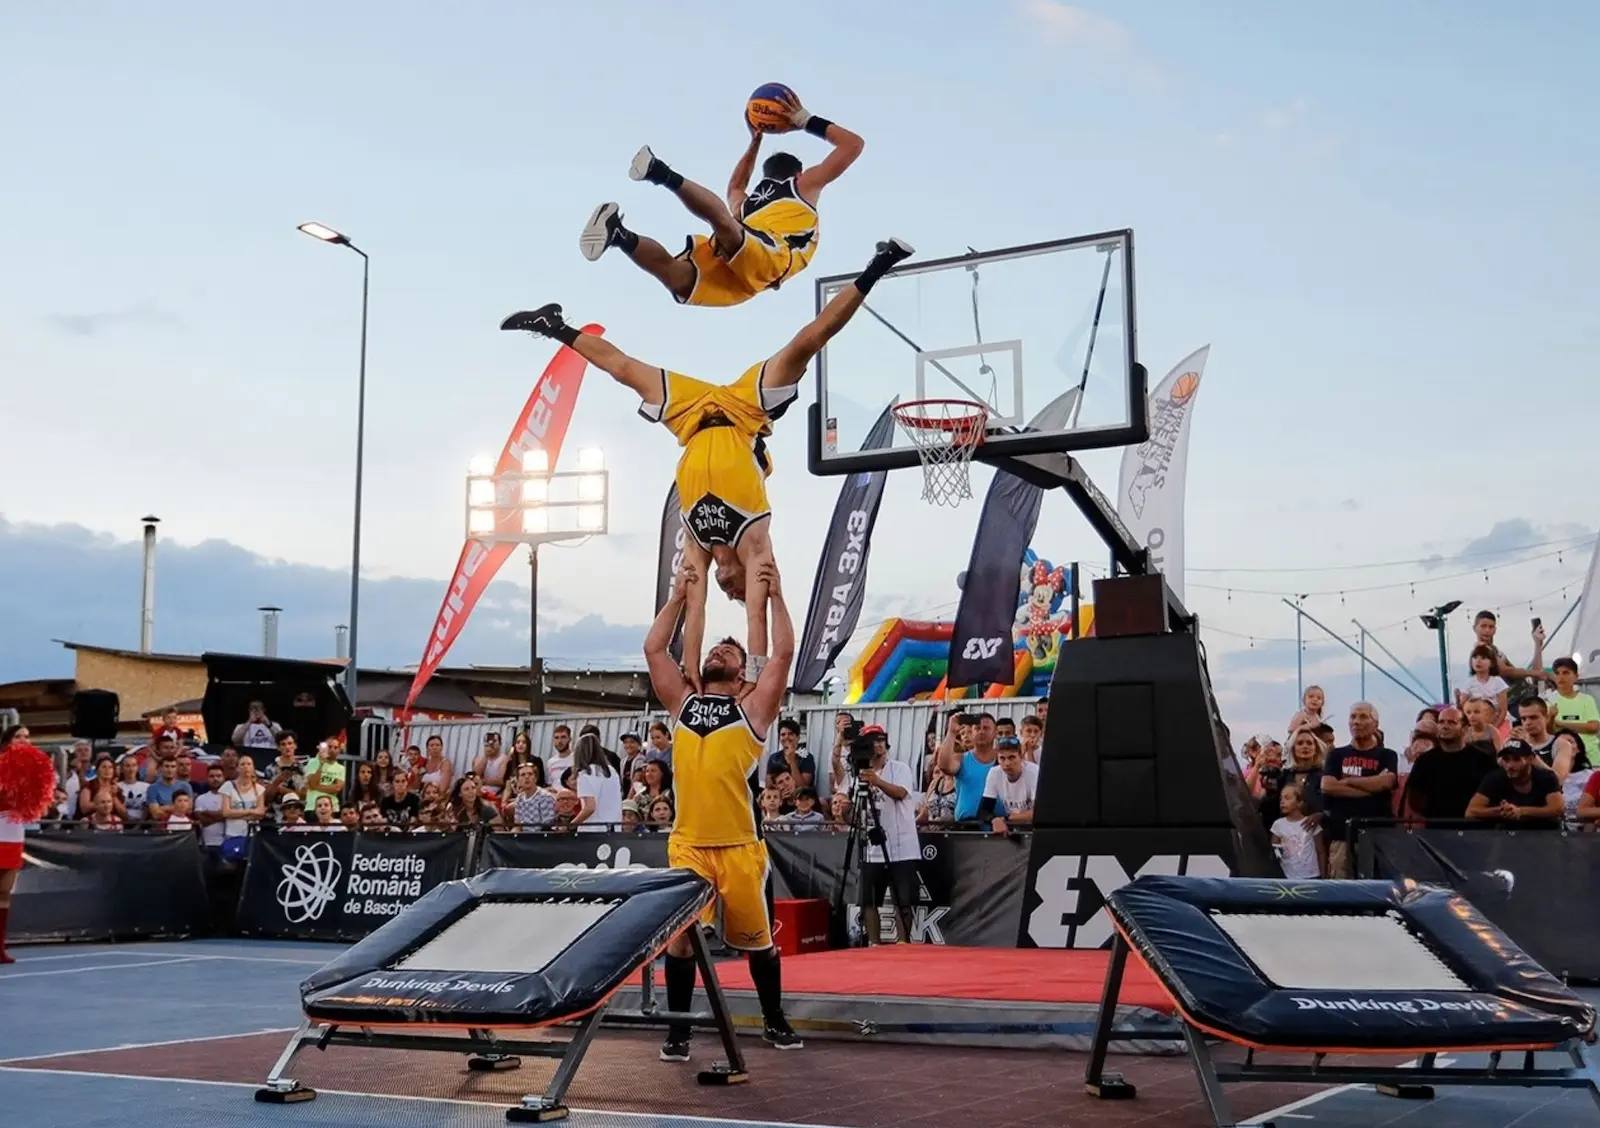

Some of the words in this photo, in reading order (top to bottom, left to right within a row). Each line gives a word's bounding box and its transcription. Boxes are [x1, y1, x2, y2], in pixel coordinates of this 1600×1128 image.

[815, 582, 853, 661] FIBA
[346, 873, 422, 897] Română
[343, 897, 362, 914] de
[361, 977, 450, 993] Dunking
[449, 980, 515, 995] Devils
[1289, 997, 1420, 1014] Dunking
[1413, 998, 1504, 1012] Devils
